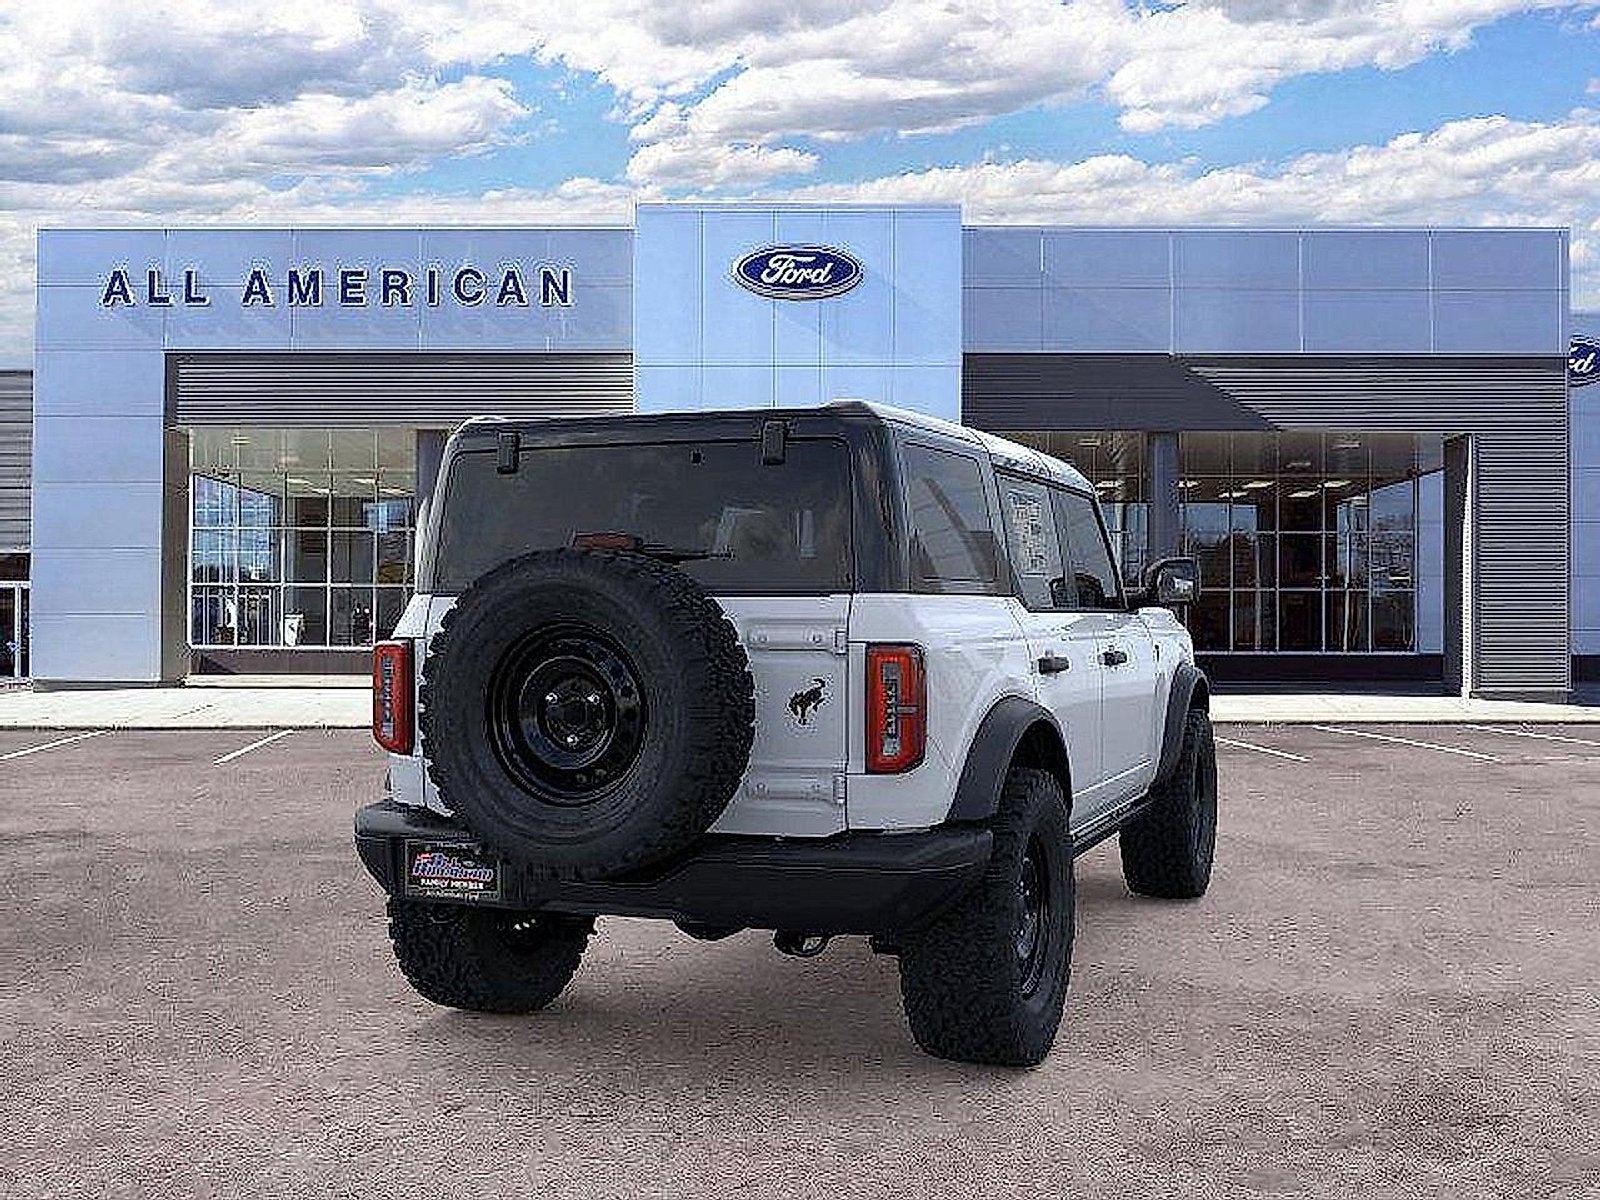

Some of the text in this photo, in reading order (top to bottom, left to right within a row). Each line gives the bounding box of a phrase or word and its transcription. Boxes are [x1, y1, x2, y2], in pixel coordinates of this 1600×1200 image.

[760, 253, 834, 284] Ford
[102, 269, 570, 306] ALL AMERICAN
